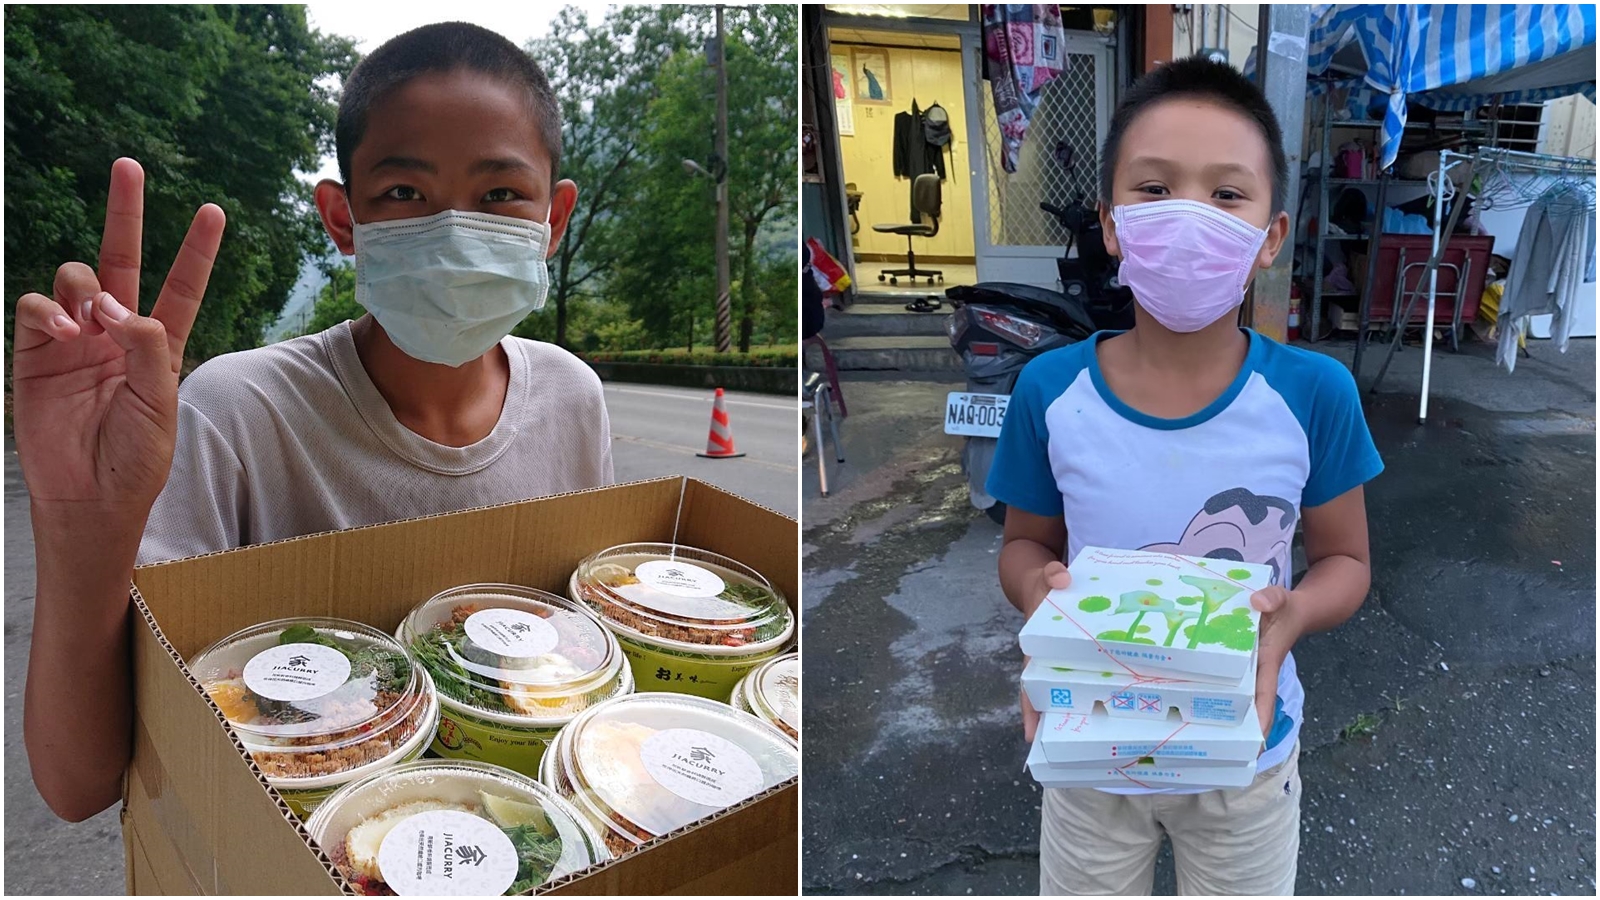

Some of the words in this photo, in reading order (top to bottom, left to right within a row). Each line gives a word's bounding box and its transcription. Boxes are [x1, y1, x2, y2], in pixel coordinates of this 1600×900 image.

[489, 734, 508, 745] Enjoy
[671, 752, 726, 777] JIACURRY
[442, 832, 454, 880] JIACURRY
